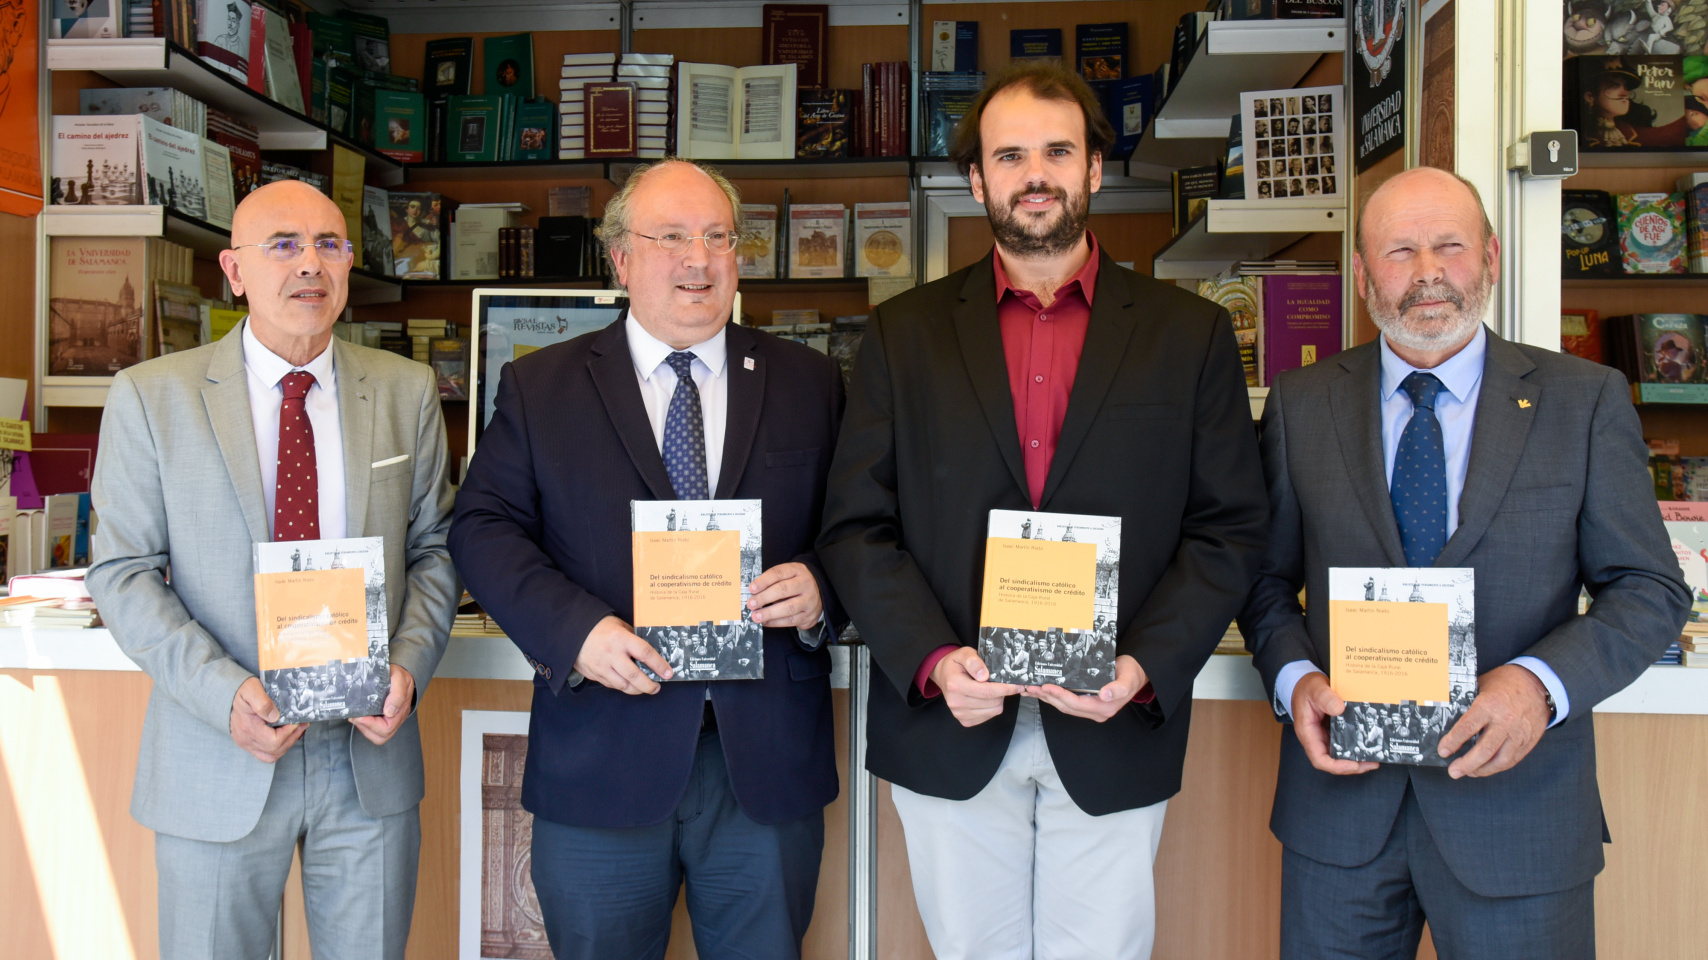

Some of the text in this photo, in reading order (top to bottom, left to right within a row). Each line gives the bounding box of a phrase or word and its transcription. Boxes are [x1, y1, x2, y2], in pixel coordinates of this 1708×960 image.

[1637, 64, 1674, 77] Peter
[1645, 76, 1675, 89] Pan
[1635, 215, 1668, 228] CUENTOS
[1640, 226, 1648, 234] DE
[1644, 233, 1661, 241] FUE
[1566, 247, 1590, 259] POP-UP
[80, 257, 126, 266] SALAMANCA
[1580, 250, 1609, 271] LUNA
[514, 322, 556, 331] REVISTAS
[1675, 512, 1705, 521] Bowie
[1006, 585, 1052, 594] cooperativismo
[1035, 666, 1062, 674] Salamanca
[1390, 742, 1420, 751] Salamanca
